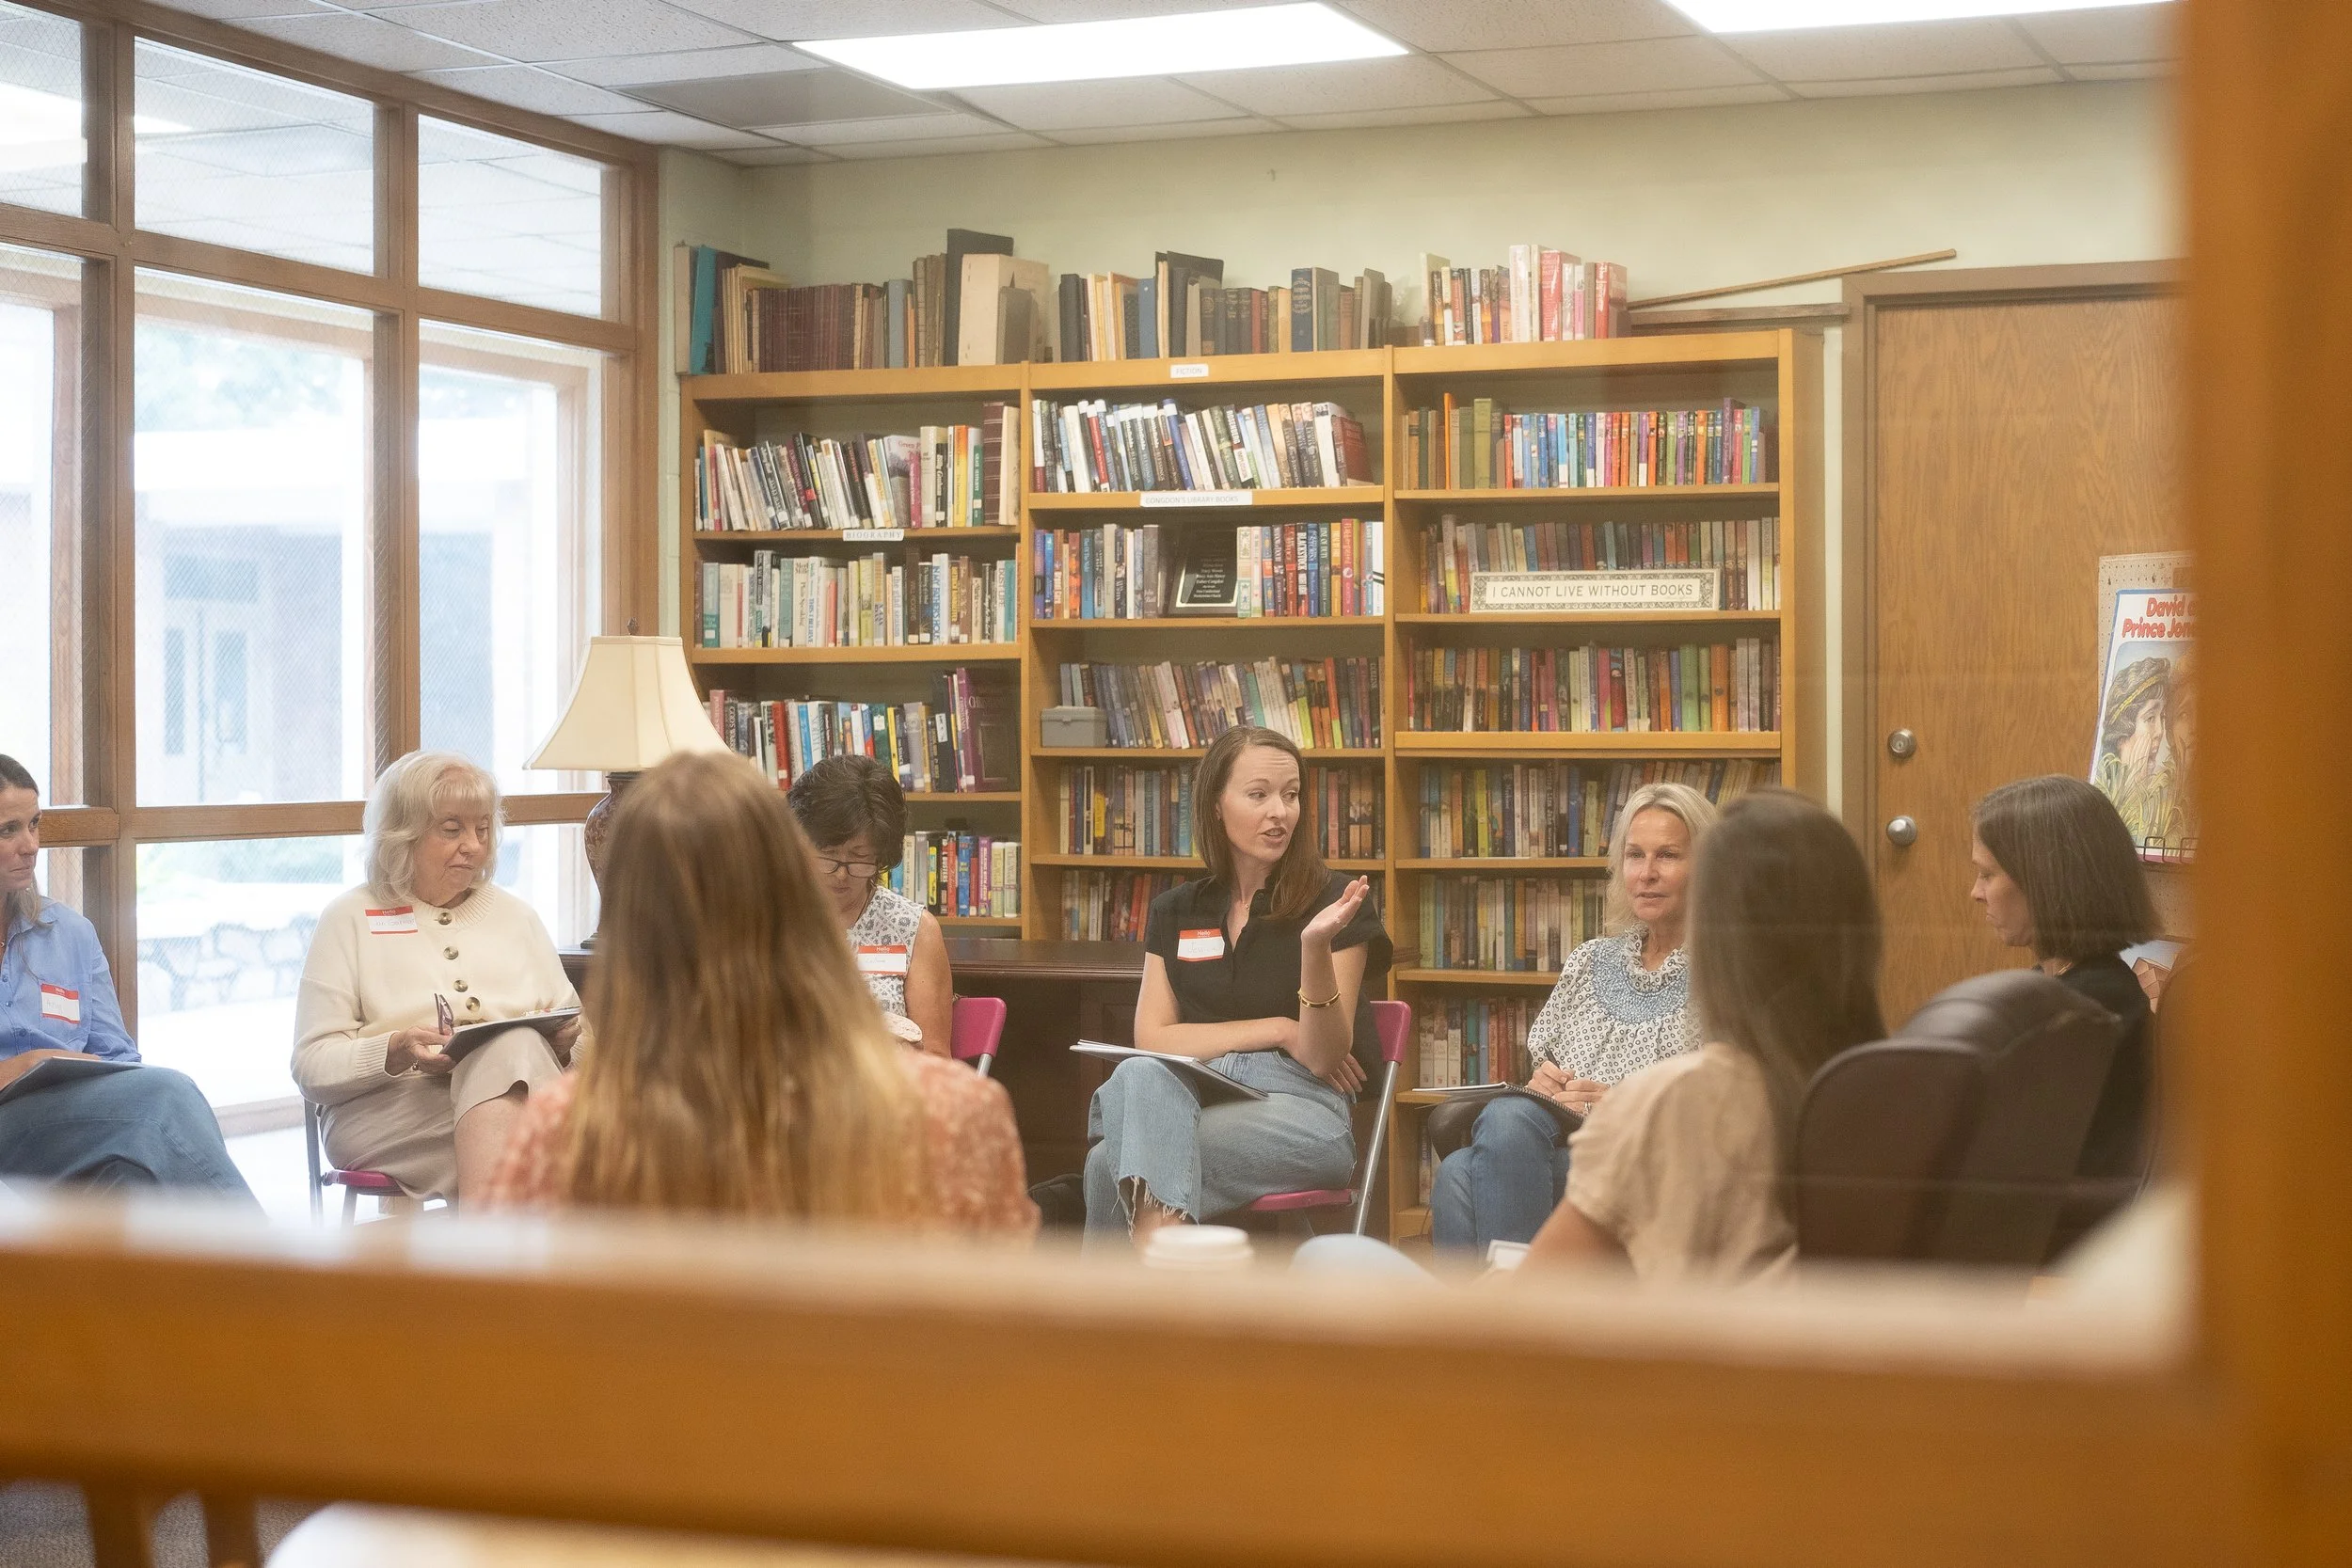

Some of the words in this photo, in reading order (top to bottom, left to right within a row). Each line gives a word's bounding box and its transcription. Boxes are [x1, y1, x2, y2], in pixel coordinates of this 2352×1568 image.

[1226, 410, 1240, 445] ROSENBERG
[1297, 531, 1308, 571] BLACKSTOCK
[1492, 587, 1496, 598] I
[1501, 586, 1550, 598] CANNOT
[1555, 585, 1583, 597] LIVE
[1588, 584, 1646, 597] WITHOUT
[1651, 584, 1693, 596] BOOKS
[2146, 594, 2186, 617] David
[2122, 616, 2166, 639] Prince
